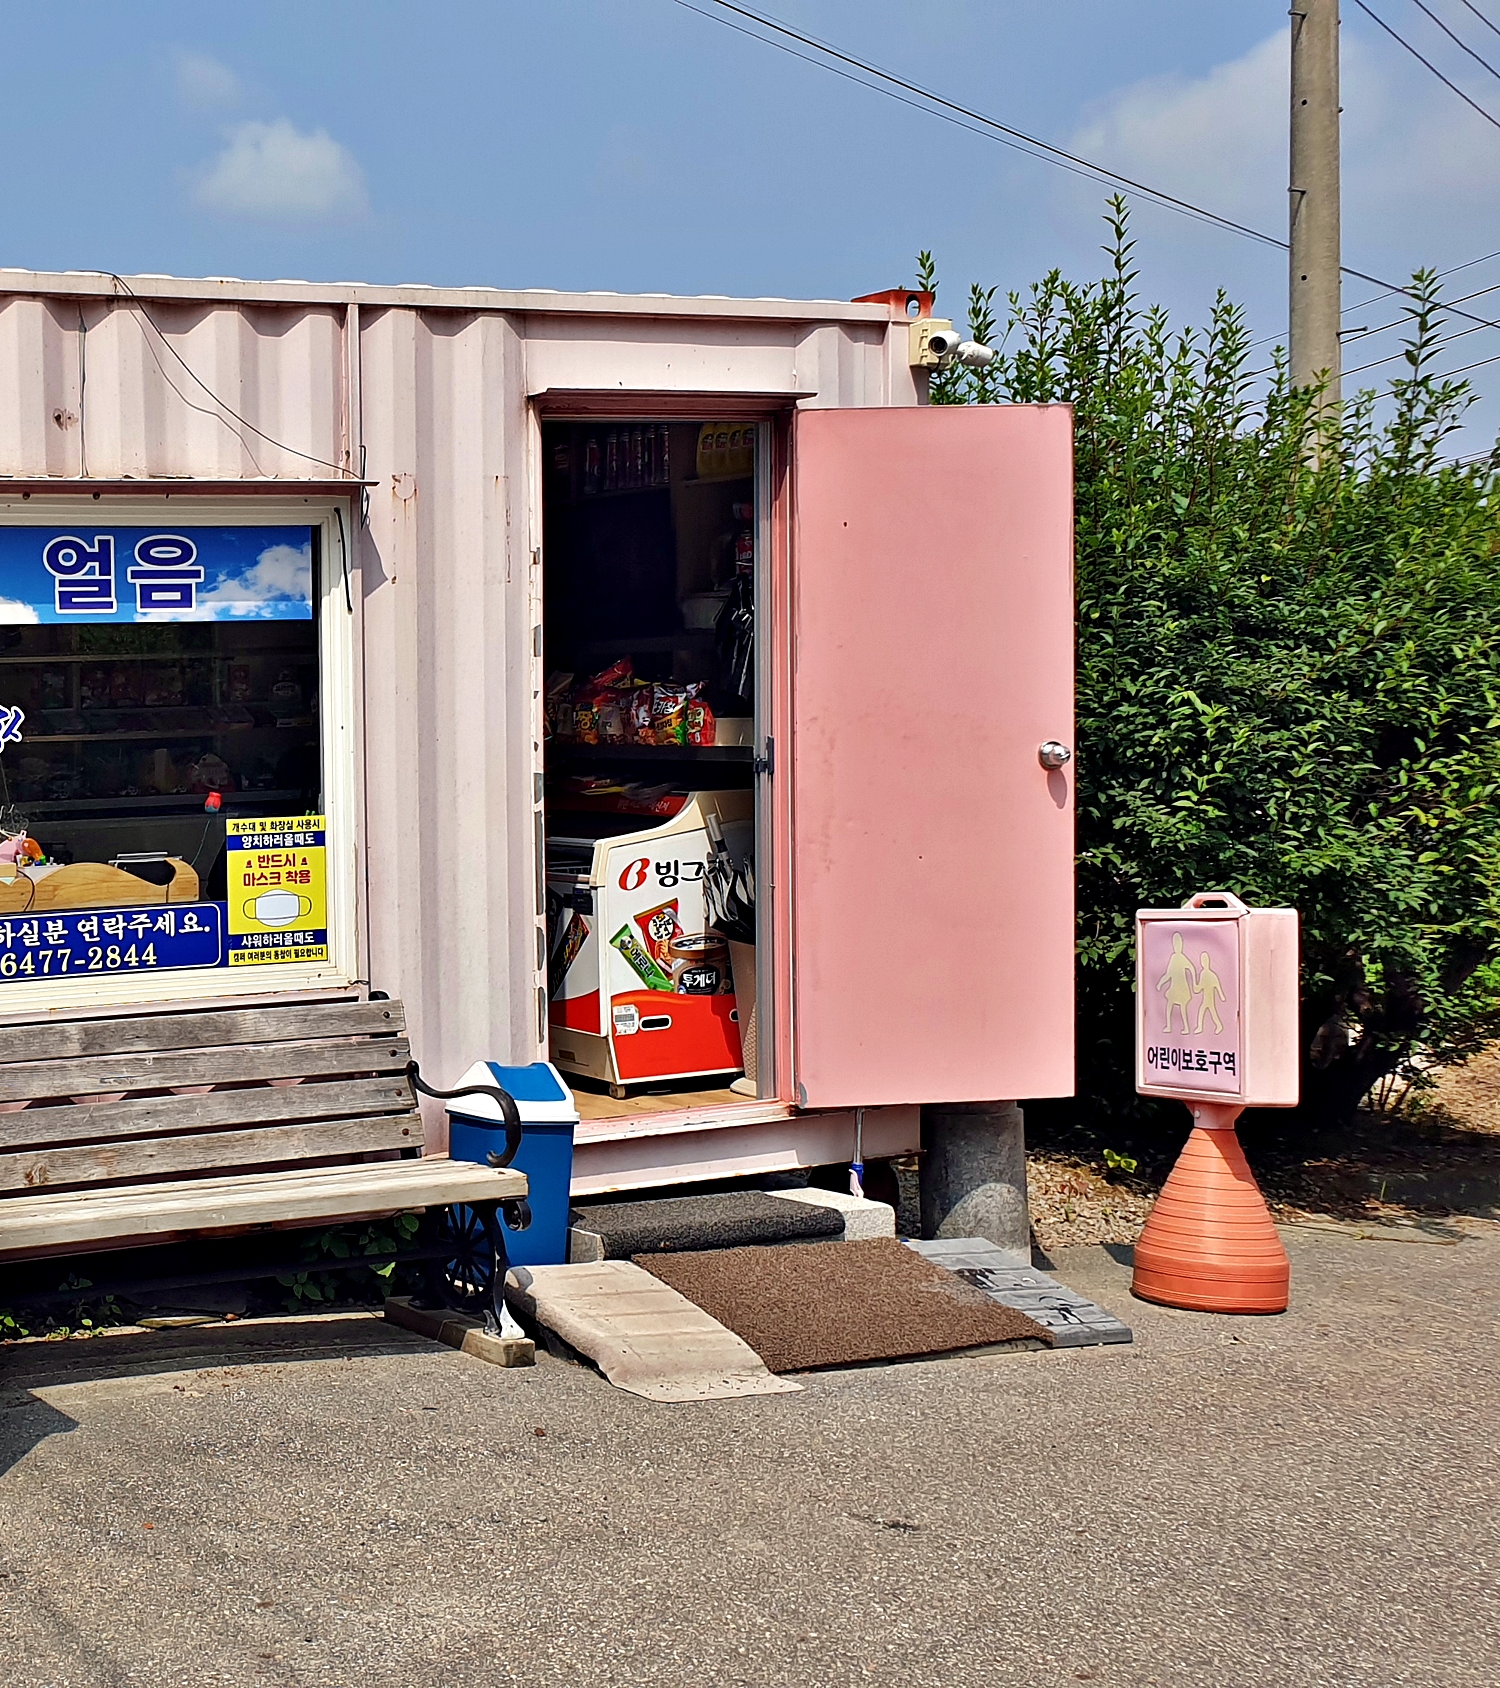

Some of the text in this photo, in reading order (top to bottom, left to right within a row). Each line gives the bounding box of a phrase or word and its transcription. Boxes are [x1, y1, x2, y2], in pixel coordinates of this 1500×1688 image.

[44, 535, 203, 613] 얼음
[232, 819, 320, 833] 개수대 및 화장실 사용시
[241, 833, 315, 848] 양치하러올때도
[257, 853, 296, 869] 반드시
[243, 870, 311, 887] 마스크 착용
[655, 859, 705, 887] 빙그
[77, 910, 211, 942] 연락주세요.
[241, 932, 315, 948] 샤워하러올때도
[247, 950, 272, 961] 여러분의
[294, 947, 323, 958] 필요합니다
[630, 947, 654, 978] 메로나
[682, 972, 716, 988] 투게더
[1147, 1046, 1236, 1076] 어린이보호구역
